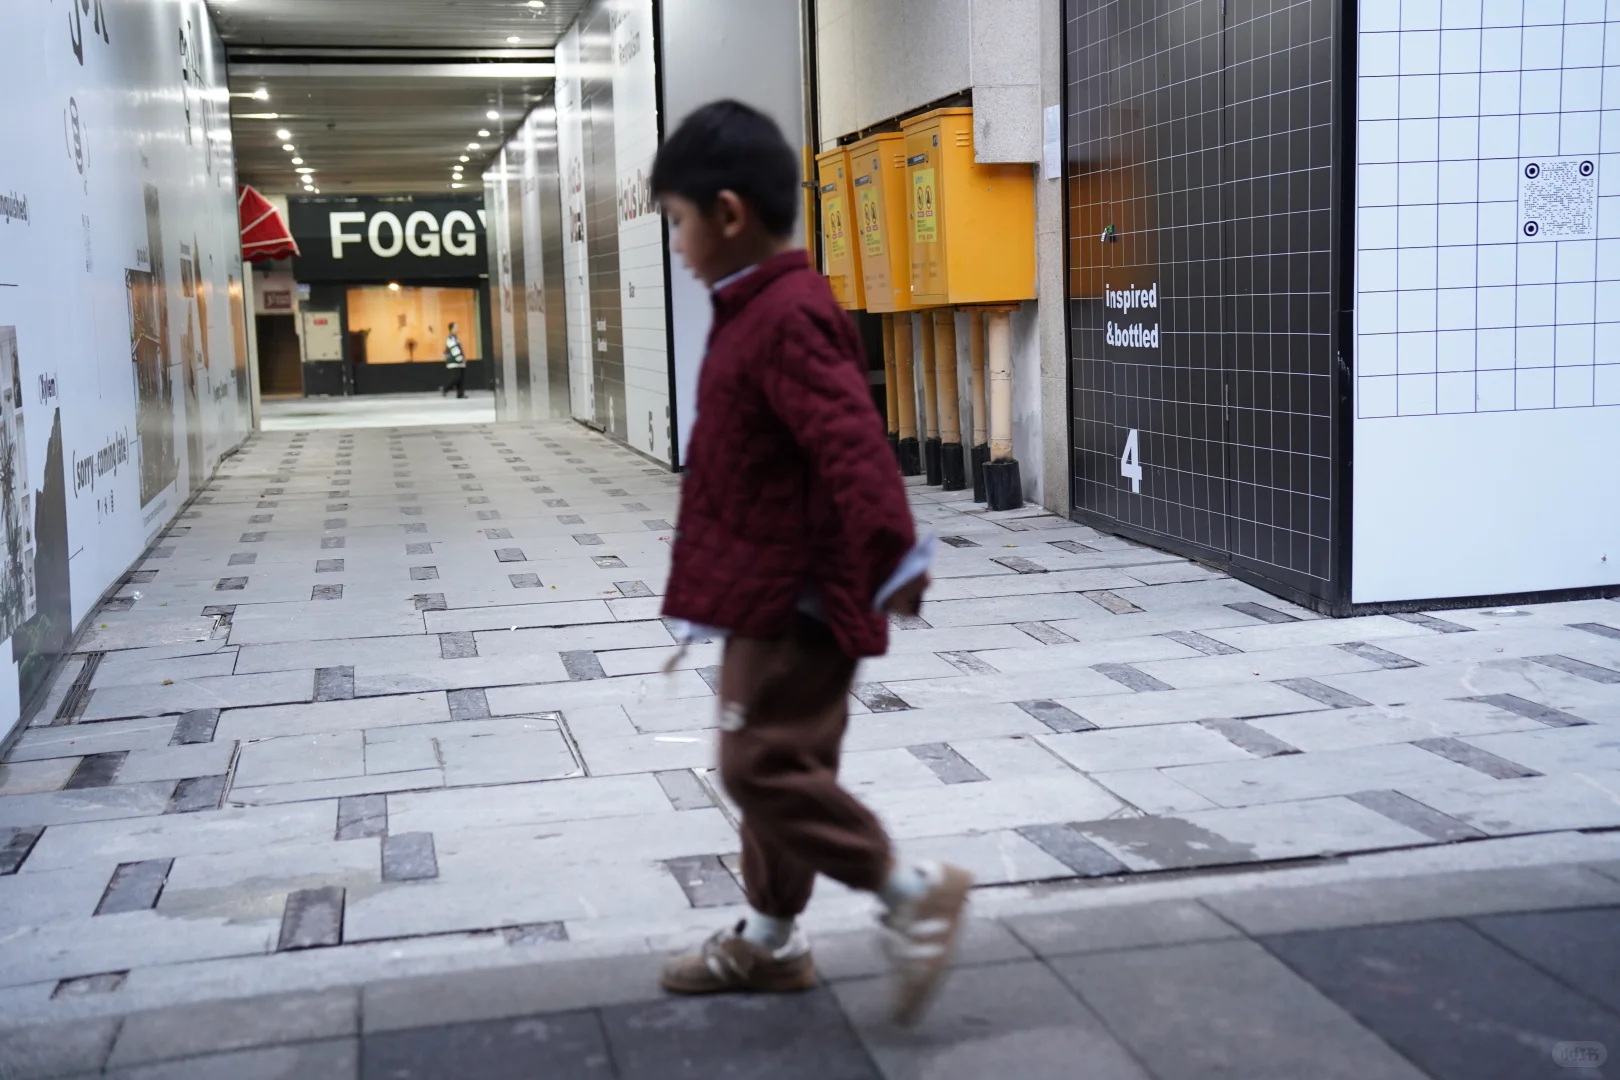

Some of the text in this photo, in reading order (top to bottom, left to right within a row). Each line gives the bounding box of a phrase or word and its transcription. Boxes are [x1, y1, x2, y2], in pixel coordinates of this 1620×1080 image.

[1106, 283, 1157, 314] inspired
[1106, 321, 1159, 348] &bottled
[648, 411, 654, 451] 5
[97, 436, 117, 477] coming
[1120, 428, 1142, 494] 4
